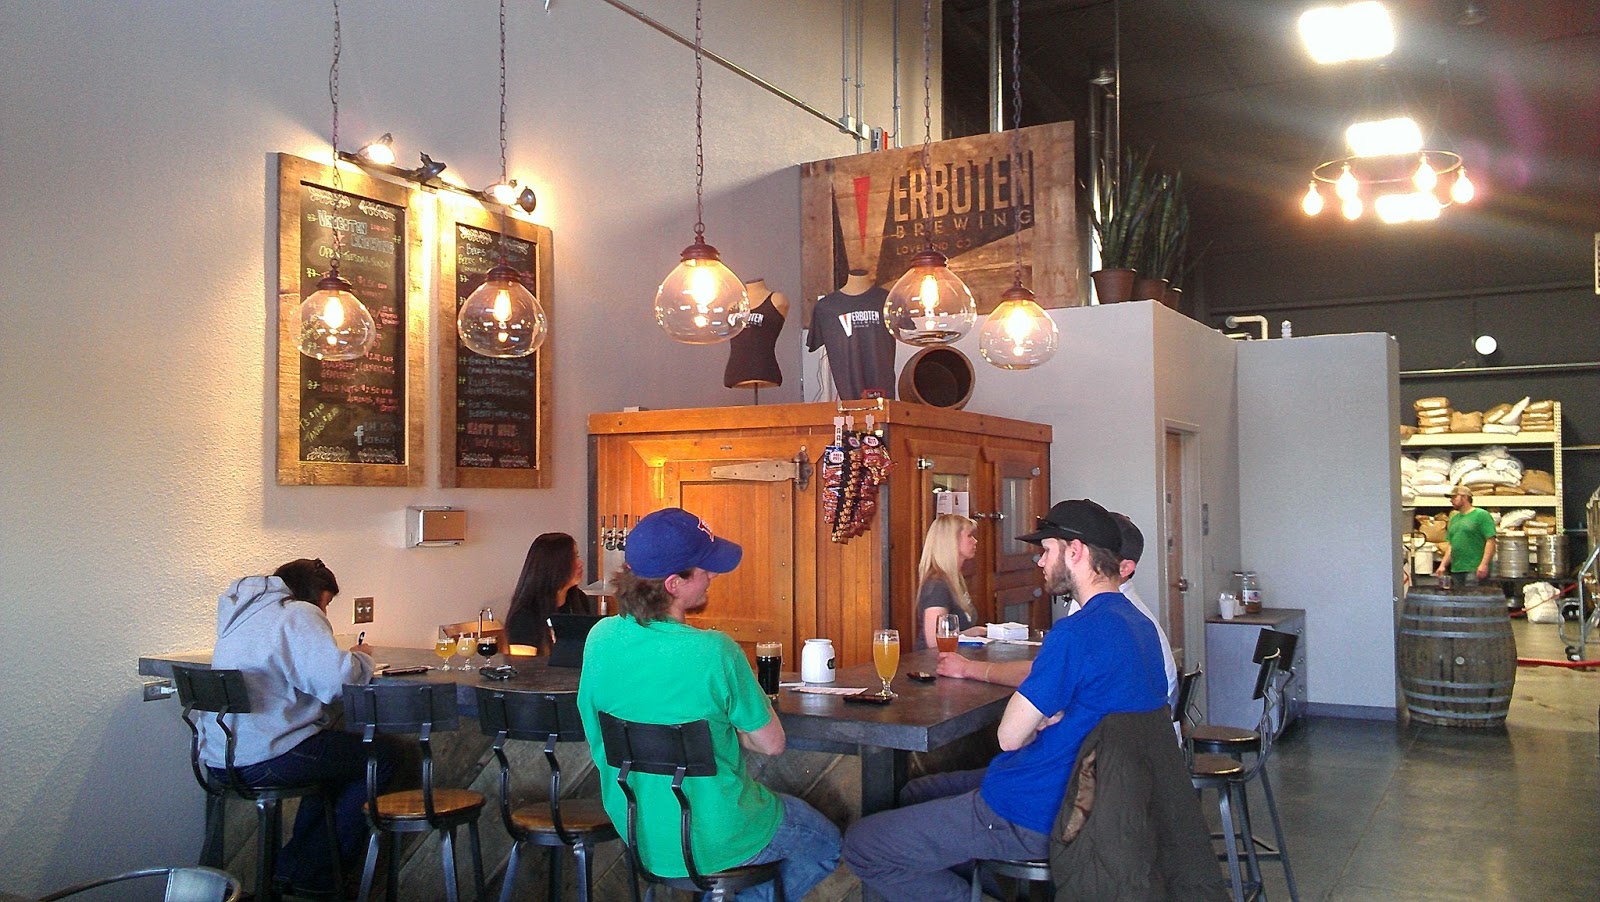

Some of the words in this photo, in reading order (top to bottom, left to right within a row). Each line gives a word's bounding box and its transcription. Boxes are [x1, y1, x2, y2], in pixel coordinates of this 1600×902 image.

[896, 209, 1033, 239] BREWING
[896, 241, 948, 256] LOVEND
[838, 310, 880, 337] VERBOTEN
